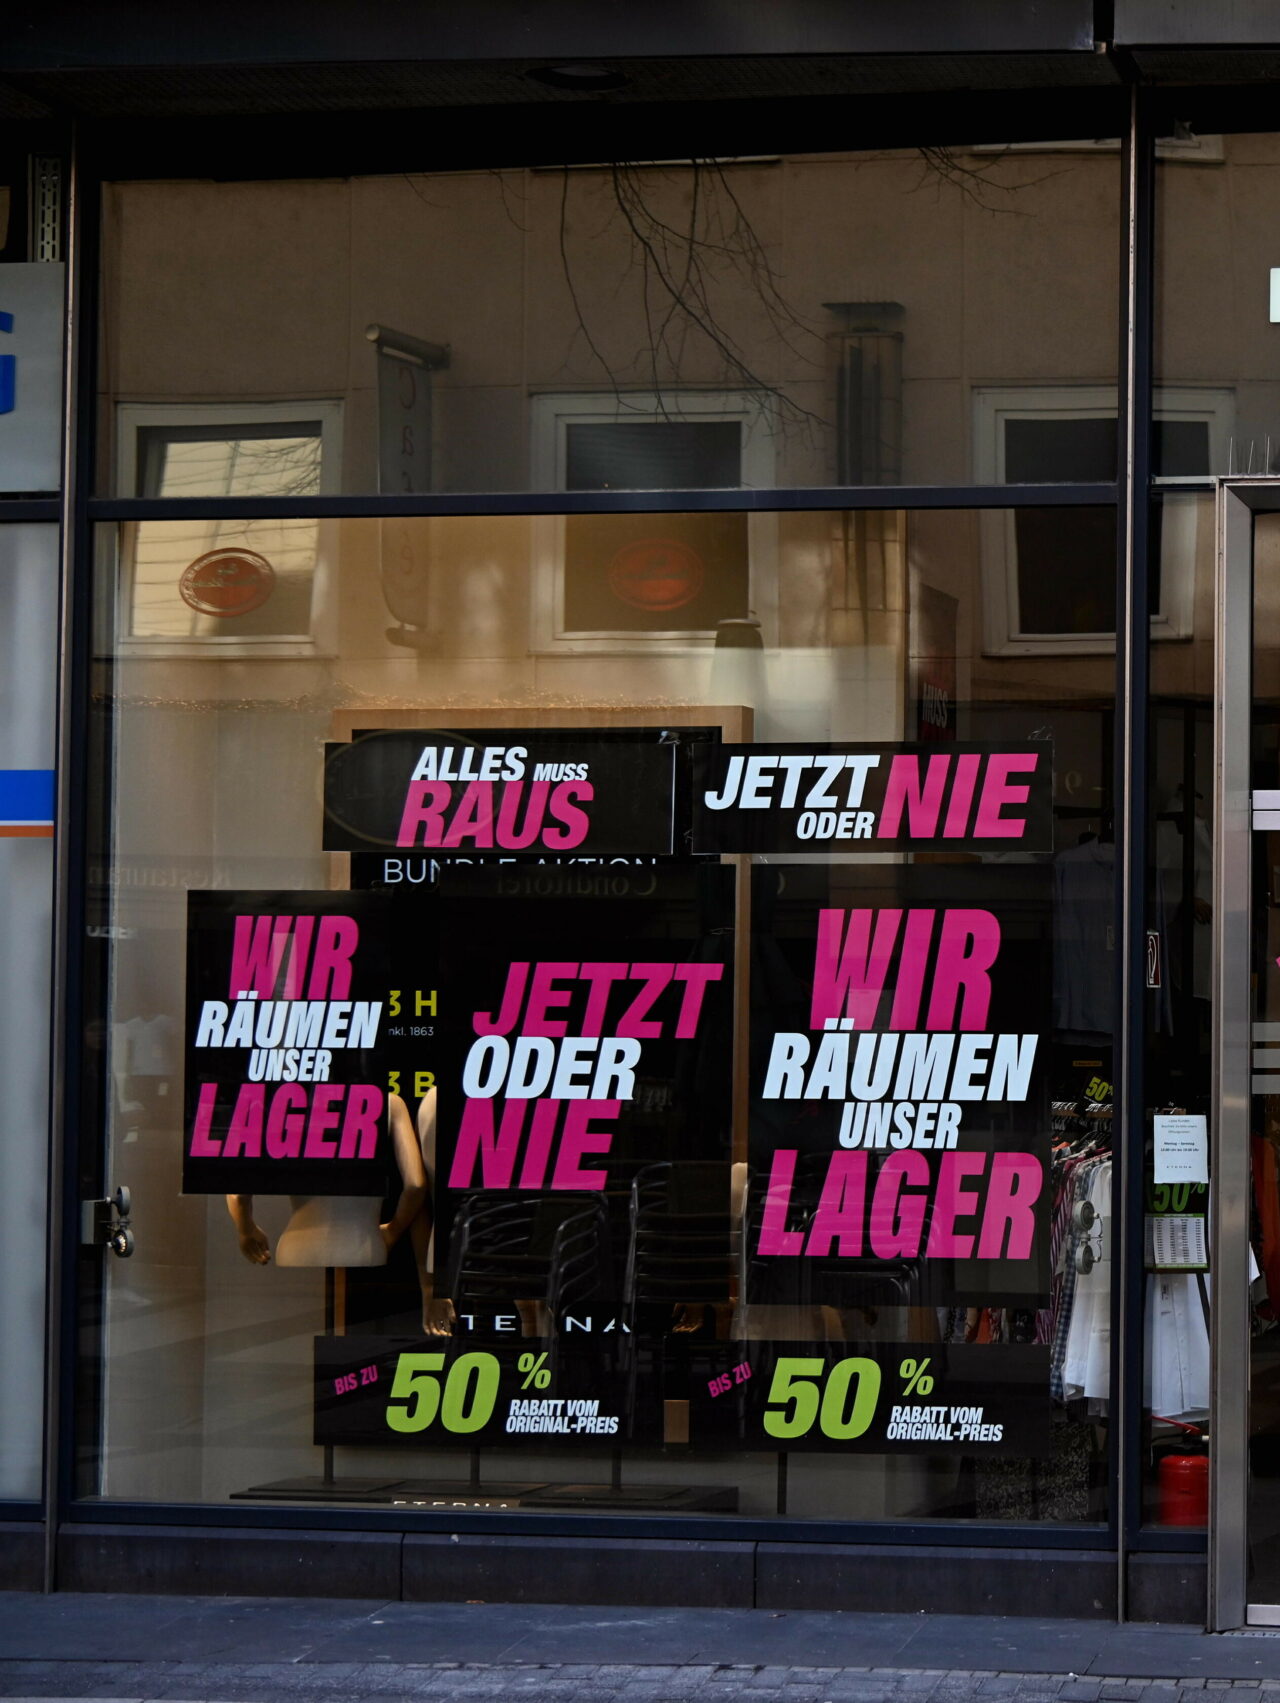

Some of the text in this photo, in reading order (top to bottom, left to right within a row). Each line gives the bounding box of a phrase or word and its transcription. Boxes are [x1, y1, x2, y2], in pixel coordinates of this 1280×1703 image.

[411, 746, 588, 782] ALLES MUSS
[704, 755, 881, 810] JETZT
[396, 780, 594, 851] RAUS
[877, 753, 1039, 839] NIE
[796, 811, 876, 840] ODER
[229, 915, 360, 1000] WIR
[810, 909, 1001, 1031] WIR
[195, 991, 383, 1049] RÄUMEN
[472, 961, 725, 1040] JETZT
[388, 1027, 434, 1037] nkl. 1863
[762, 1018, 1039, 1102] RÄUMEN
[247, 1048, 332, 1083] UNSER
[463, 1035, 642, 1101] ODER
[190, 1082, 384, 1160] LAGER
[448, 1098, 622, 1191] NIE
[838, 1101, 963, 1149] UNSER
[757, 1149, 1044, 1260] LAGER
[460, 1314, 632, 1333] TENA
[334, 1365, 379, 1395] BIS ZU
[386, 1352, 552, 1434] 50 %
[707, 1361, 753, 1398] BIS ZU
[763, 1357, 934, 1440] 50 %
[506, 1415, 619, 1434] ORIGINAL-PREIS
[509, 1400, 600, 1417] RABATT VOM
[886, 1421, 1004, 1442] ORIGINAL-PREIS
[891, 1406, 984, 1424] RABATT VOM
